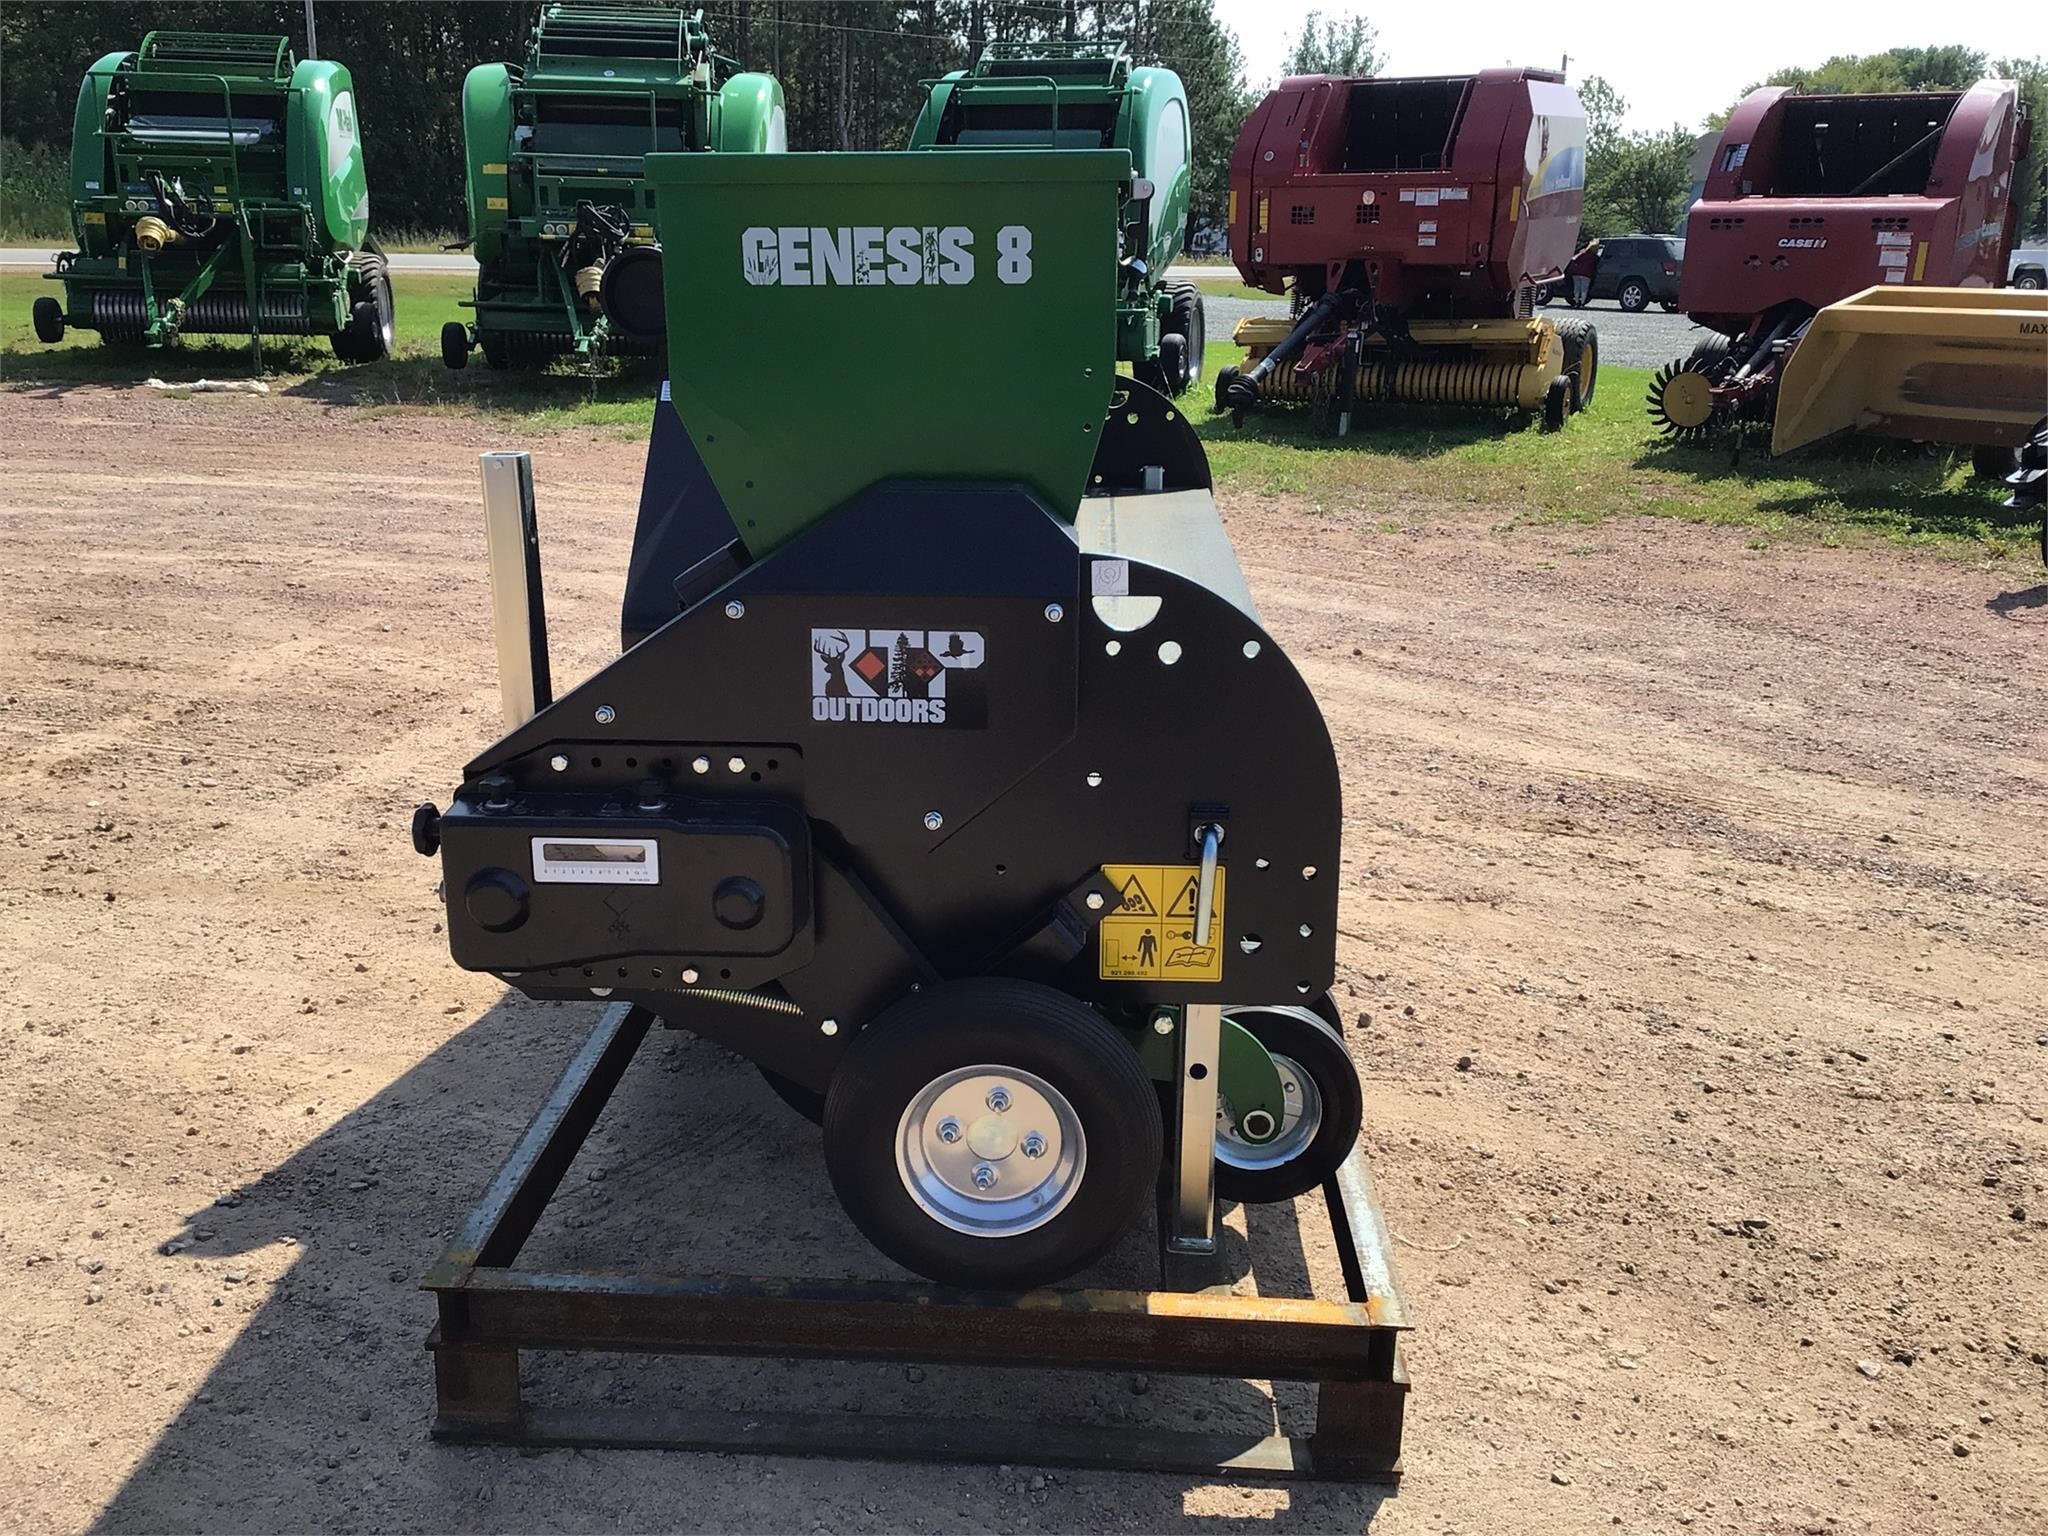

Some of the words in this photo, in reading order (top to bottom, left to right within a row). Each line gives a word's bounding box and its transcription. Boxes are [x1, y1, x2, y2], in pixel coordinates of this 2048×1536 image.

[742, 226, 974, 285] GENESIS
[997, 225, 1032, 284] 8
[812, 697, 946, 723] OUTDOORS
